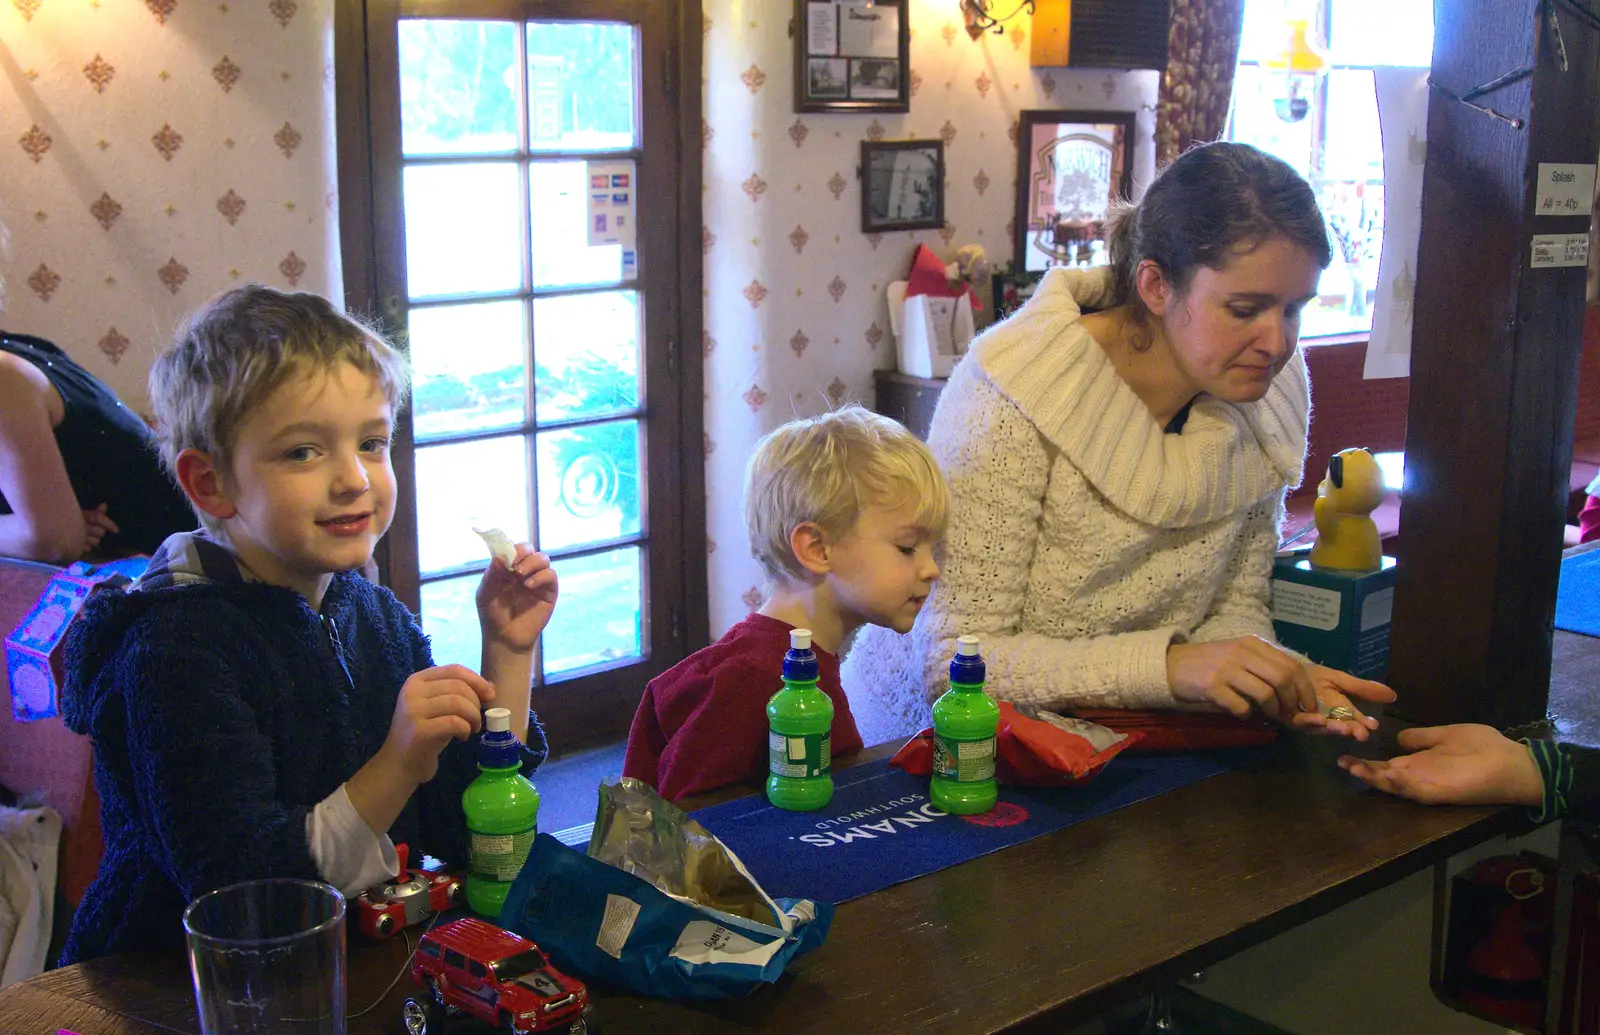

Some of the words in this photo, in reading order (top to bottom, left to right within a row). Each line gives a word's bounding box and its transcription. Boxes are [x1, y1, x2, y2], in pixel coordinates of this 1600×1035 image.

[1551, 171, 1576, 183] Splash
[815, 793, 925, 829] SOUTHWOLD
[535, 977, 550, 988] 4
